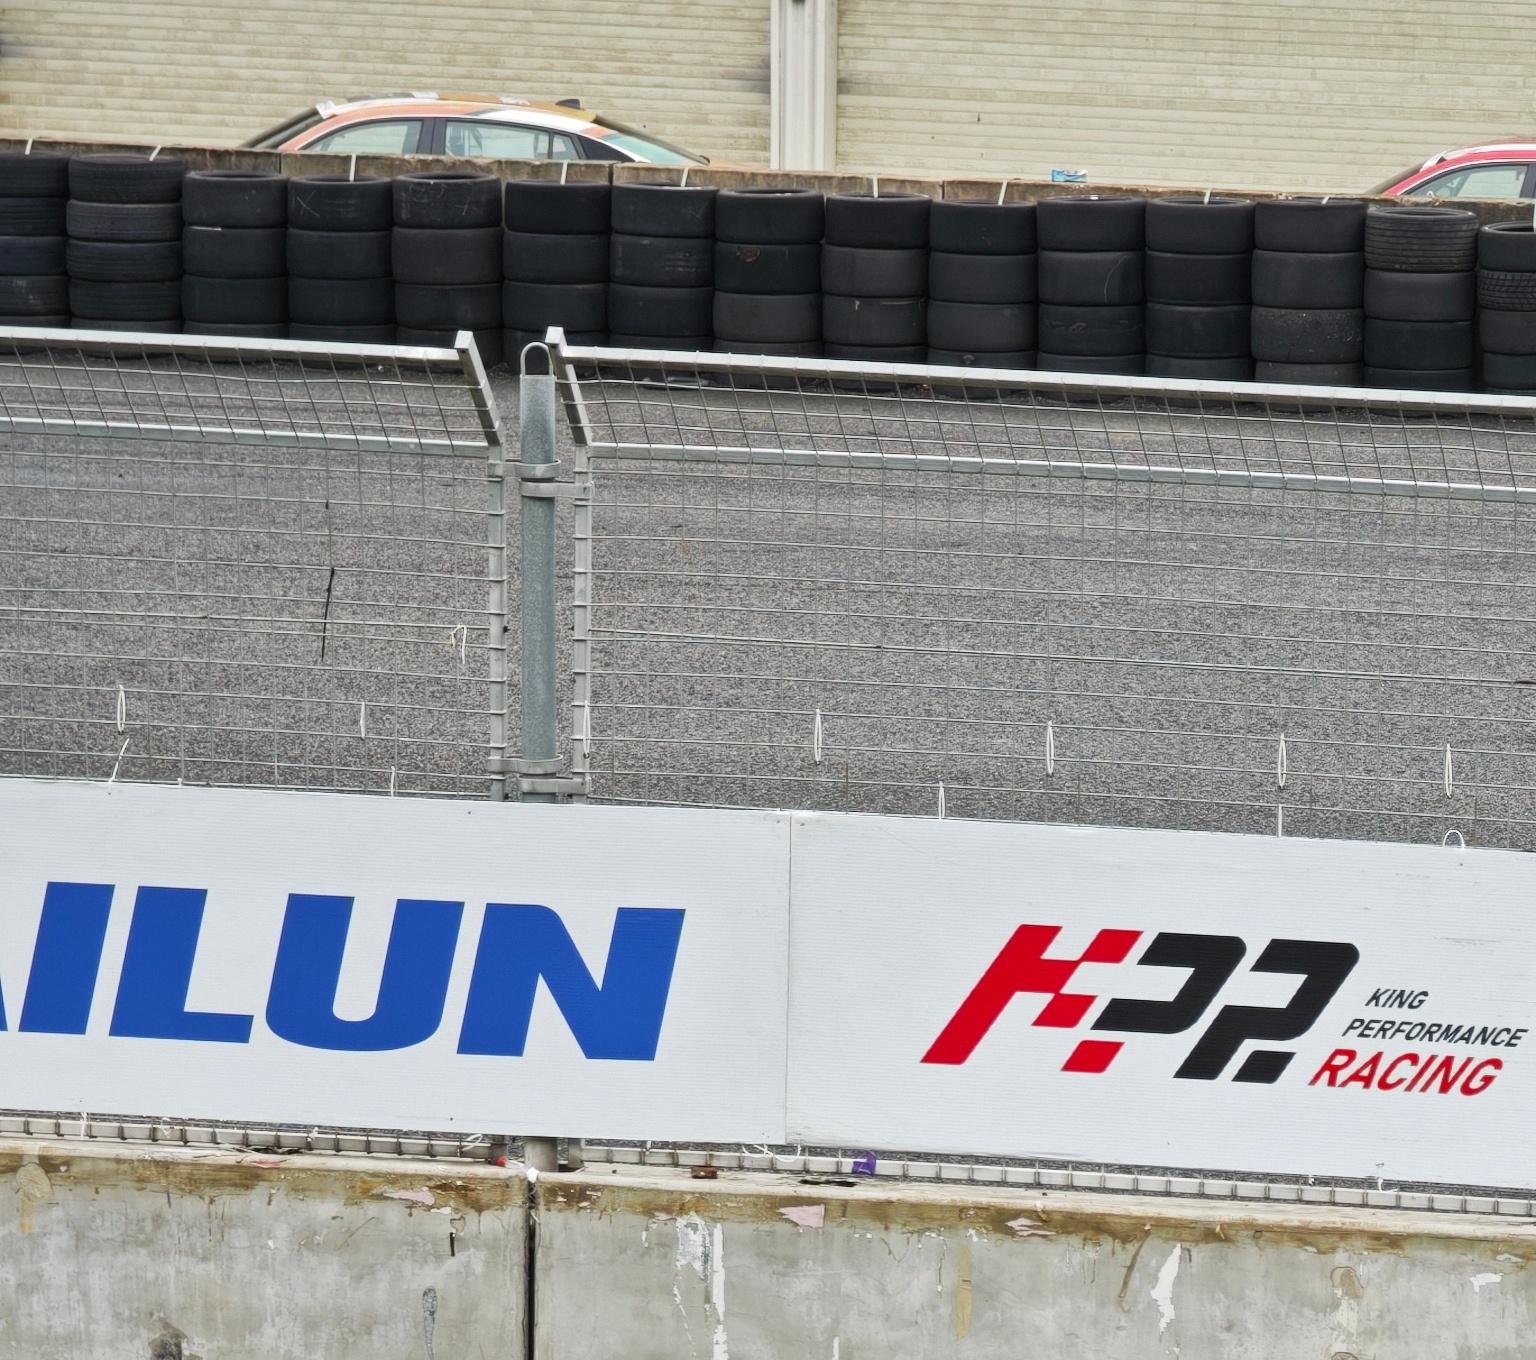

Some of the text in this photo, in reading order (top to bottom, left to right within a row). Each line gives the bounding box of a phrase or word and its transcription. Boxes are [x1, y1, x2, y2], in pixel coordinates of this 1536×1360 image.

[0, 881, 687, 1062] ILUN
[1365, 987, 1429, 1010] KING
[1342, 1018, 1528, 1048] PERFORMANCE
[1307, 1048, 1504, 1097] RACING
